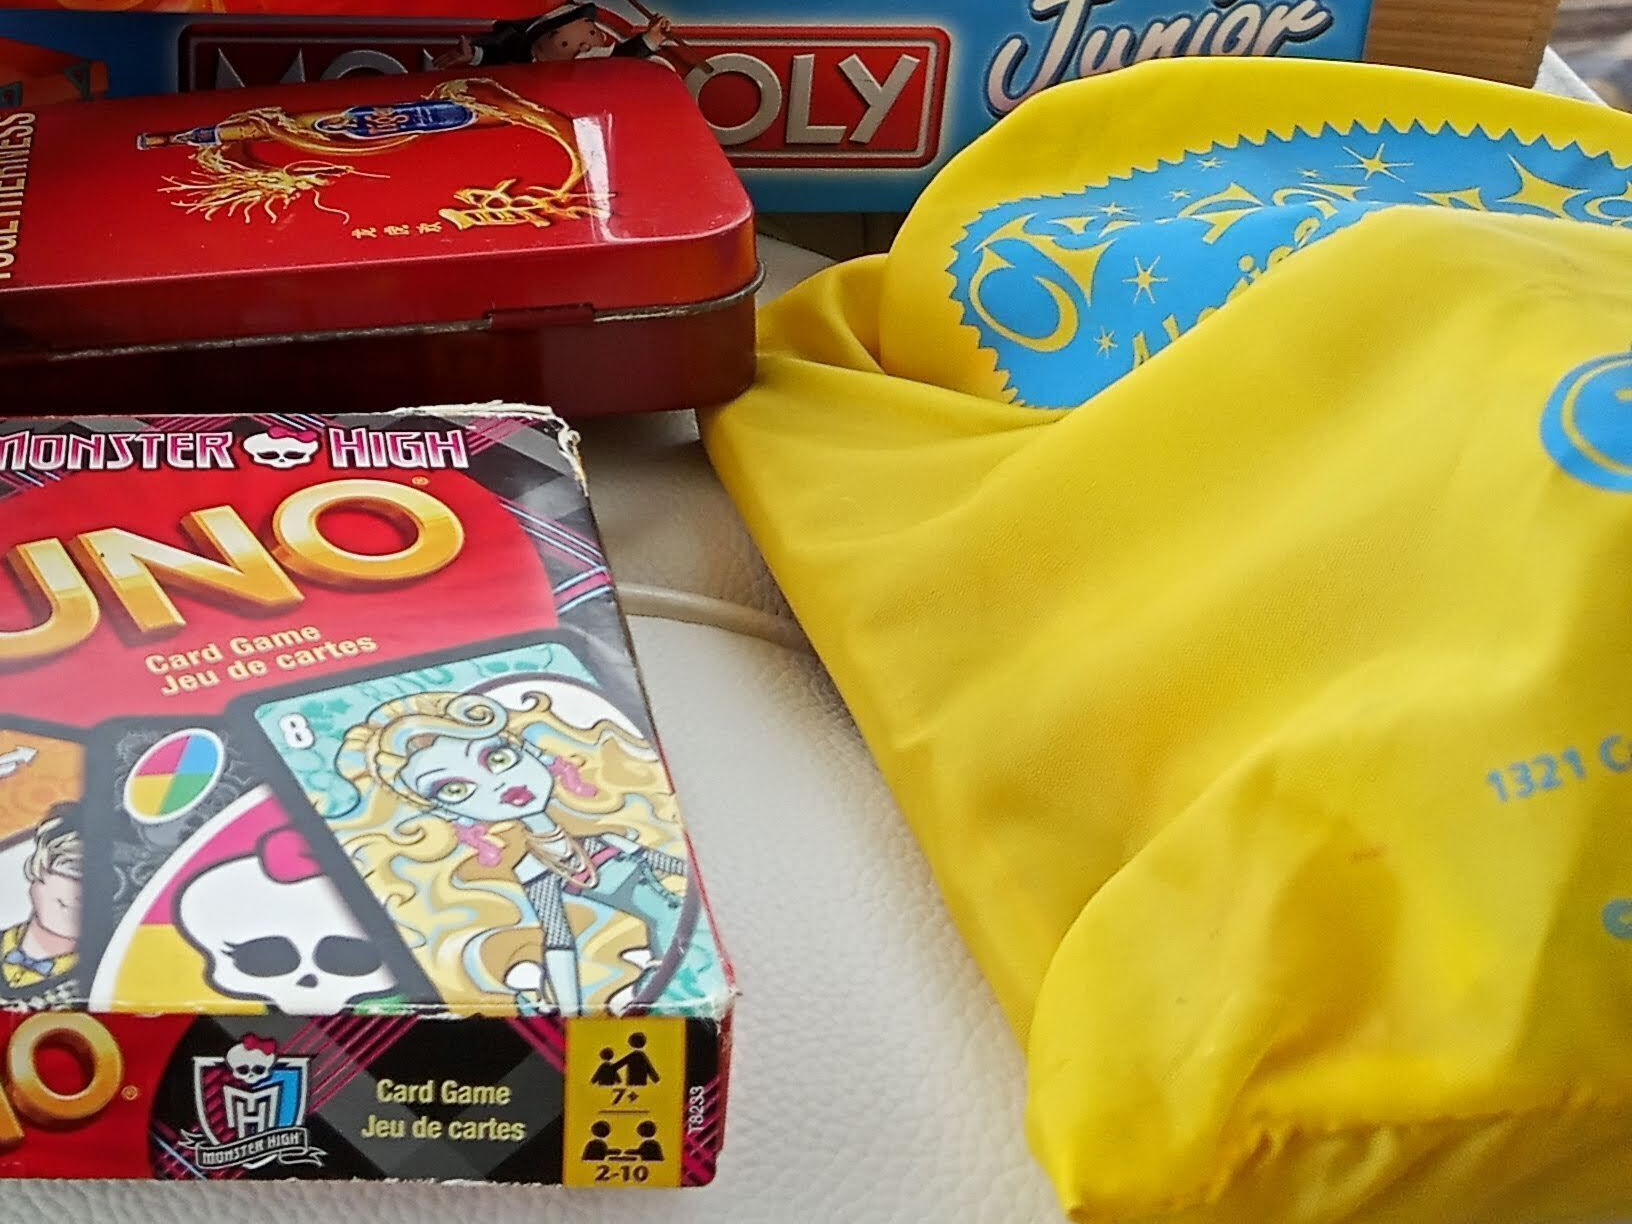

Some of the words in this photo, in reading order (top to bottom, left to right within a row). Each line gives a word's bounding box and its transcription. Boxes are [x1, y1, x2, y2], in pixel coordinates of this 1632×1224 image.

[330, 428, 469, 471] HIGH
[145, 642, 224, 676] Card
[230, 623, 321, 662] Game
[160, 664, 220, 697] Jeu
[226, 655, 268, 681] de
[274, 634, 378, 671] cartes
[278, 714, 315, 750] 8
[1486, 745, 1587, 803] 1321
[376, 1078, 434, 1104] Card
[441, 1079, 512, 1105] Game
[612, 1087, 639, 1106] 7+
[361, 1114, 407, 1140] Jeu
[411, 1116, 443, 1139] de
[447, 1118, 527, 1142] cartes
[687, 1085, 706, 1135] T8233
[202, 1139, 265, 1165] MONSTER
[267, 1131, 302, 1149] HIGH
[595, 1164, 650, 1184] 2-10
